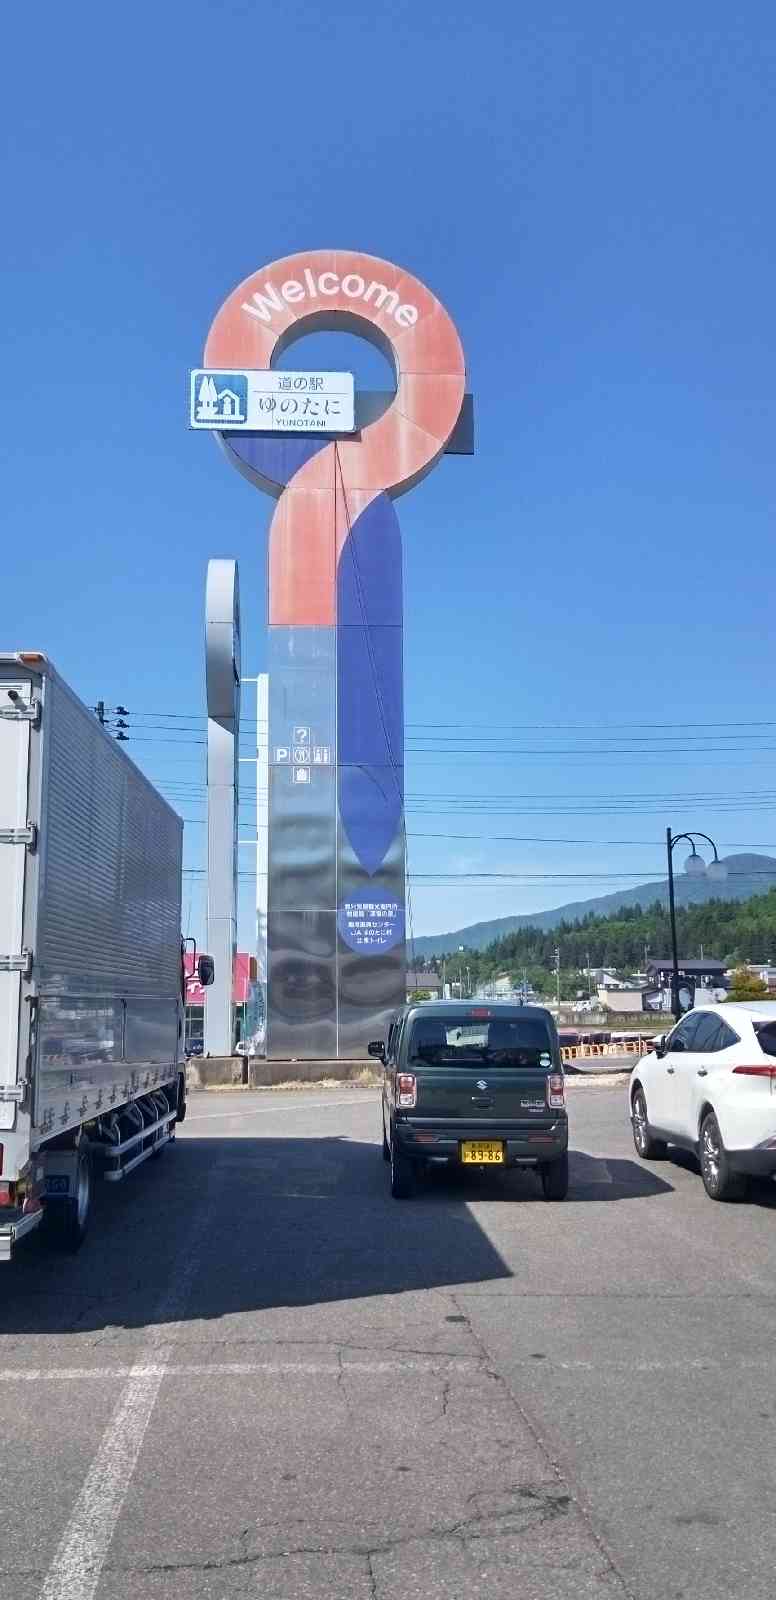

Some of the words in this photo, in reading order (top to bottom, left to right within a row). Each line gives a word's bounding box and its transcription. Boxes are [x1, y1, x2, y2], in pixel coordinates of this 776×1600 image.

[241, 268, 419, 328] Welcome
[278, 376, 325, 391] 道の駅
[258, 397, 341, 416] ゆのたに
[275, 418, 326, 427] YUNOTANI
[276, 748, 287, 762] P
